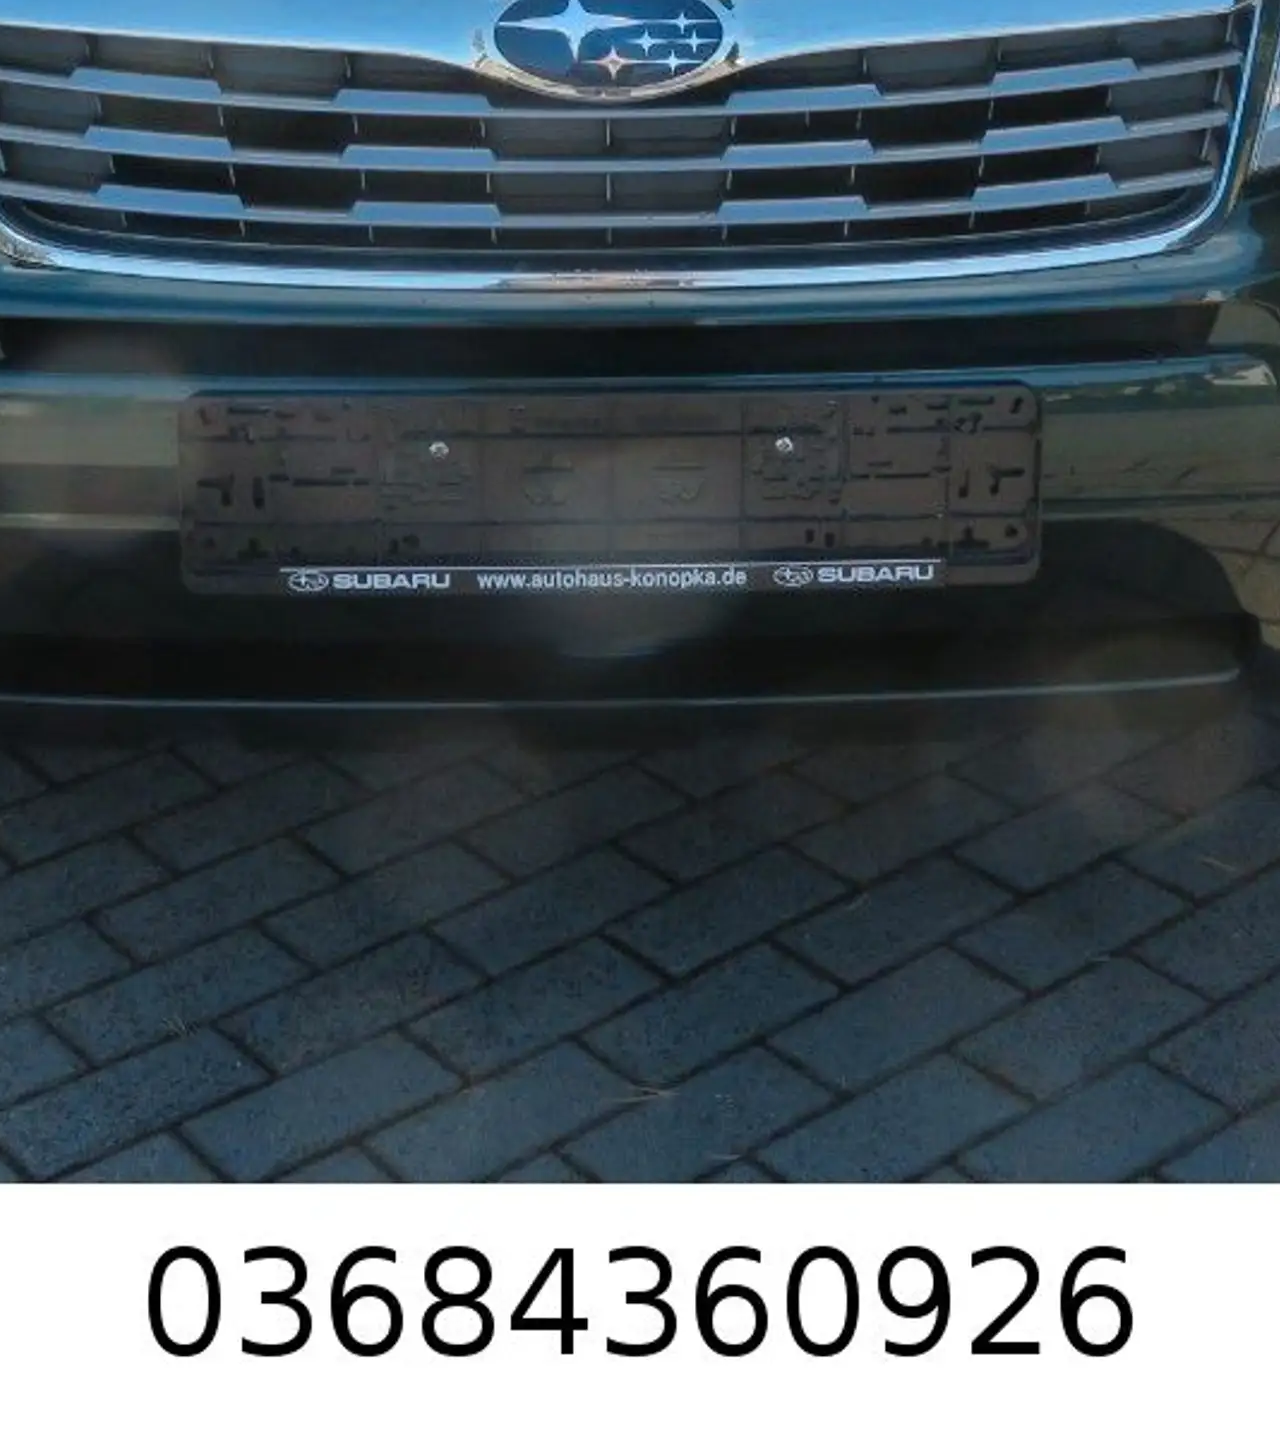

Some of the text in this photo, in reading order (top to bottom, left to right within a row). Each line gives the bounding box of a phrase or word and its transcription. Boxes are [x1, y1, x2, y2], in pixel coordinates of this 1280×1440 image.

[332, 564, 934, 591] SUBARU www.autohaus-konopka.de SUBARU
